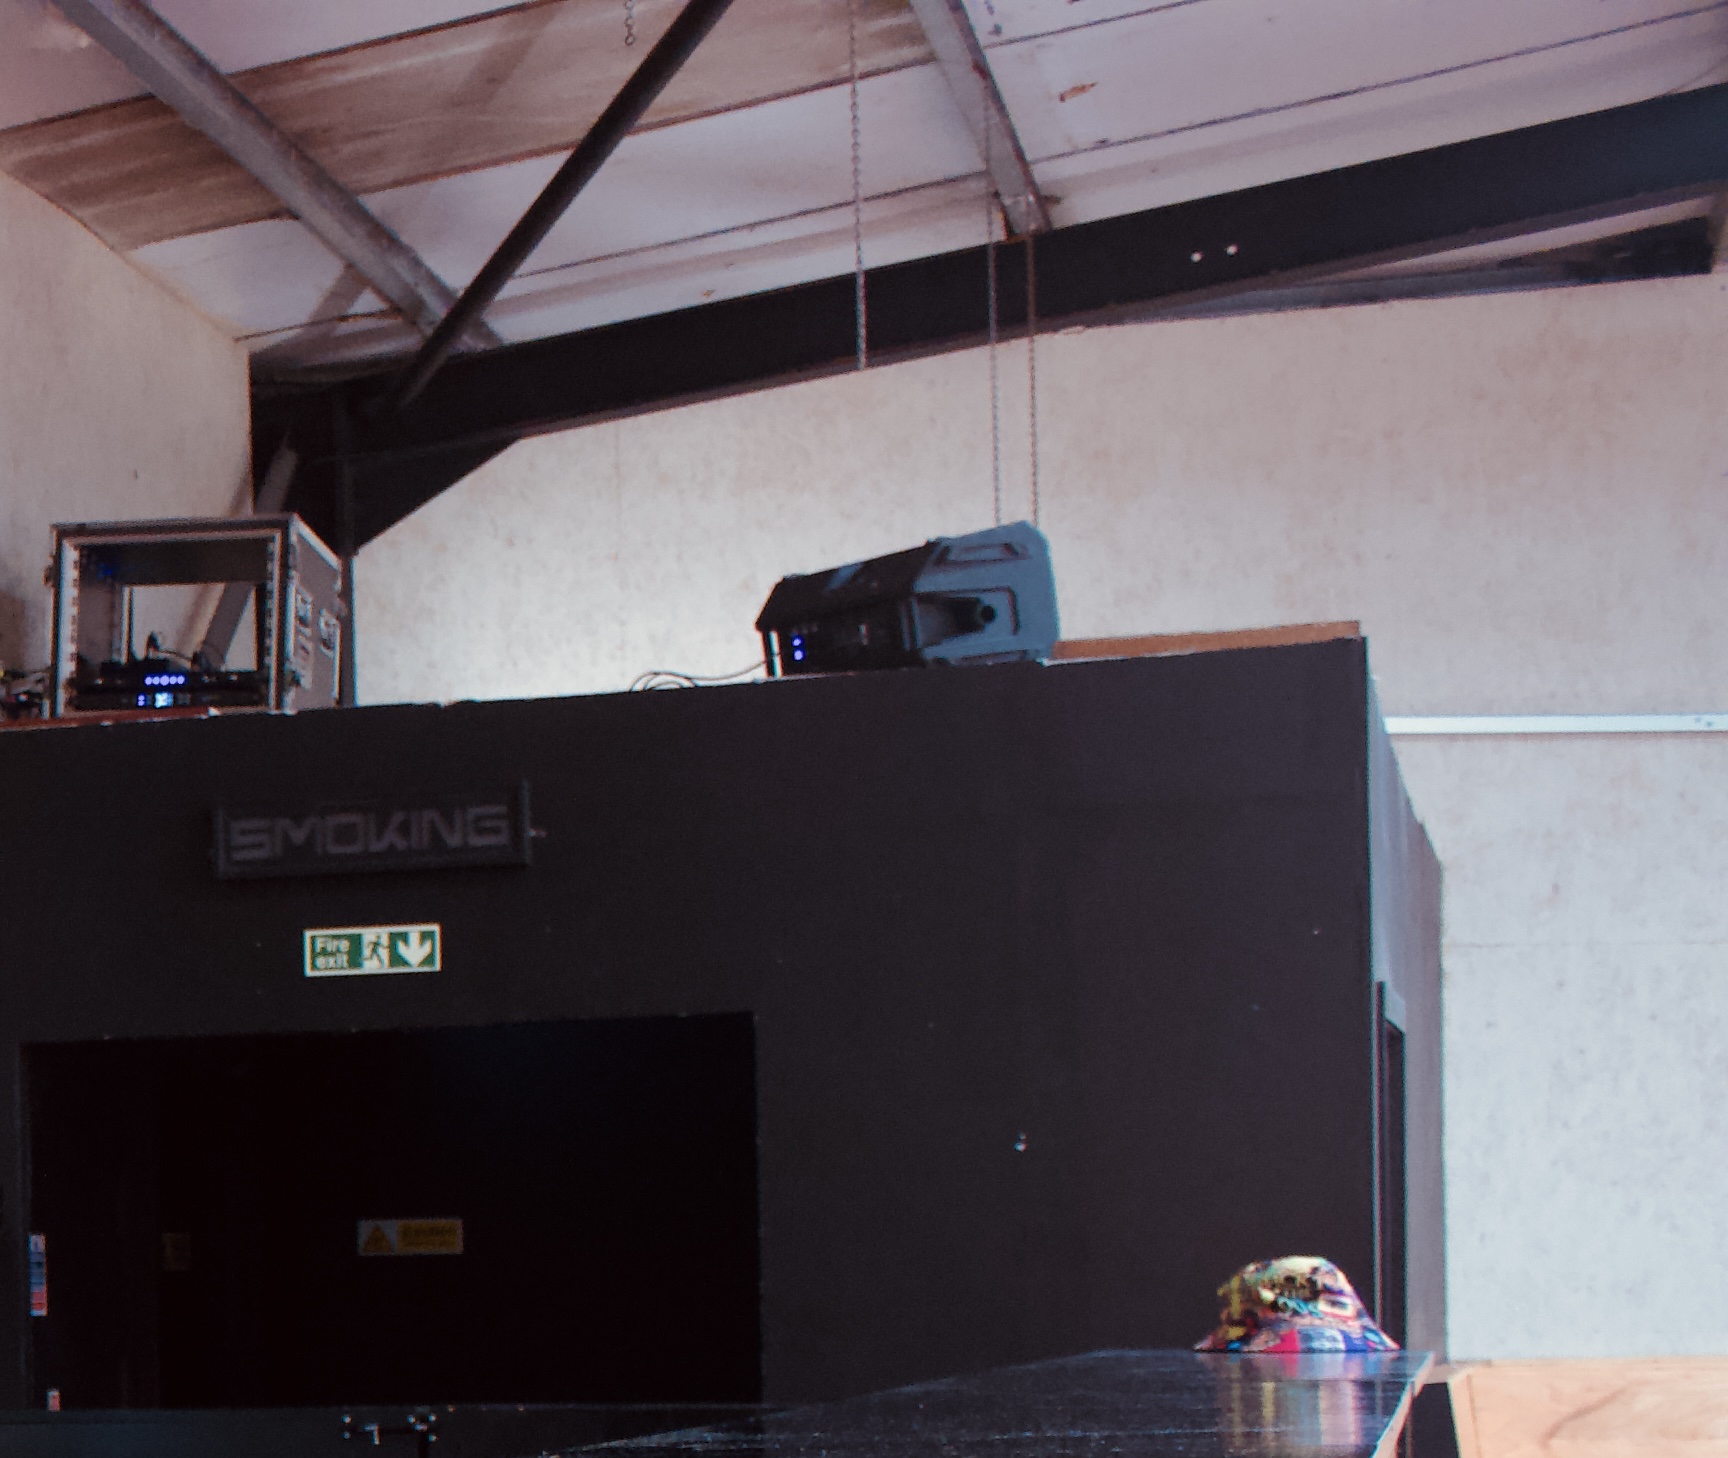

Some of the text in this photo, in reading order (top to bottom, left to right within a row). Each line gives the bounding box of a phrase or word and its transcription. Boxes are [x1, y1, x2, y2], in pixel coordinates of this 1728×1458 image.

[229, 804, 510, 862] SMOKING
[313, 937, 350, 953] Fire
[313, 953, 350, 971] exit
